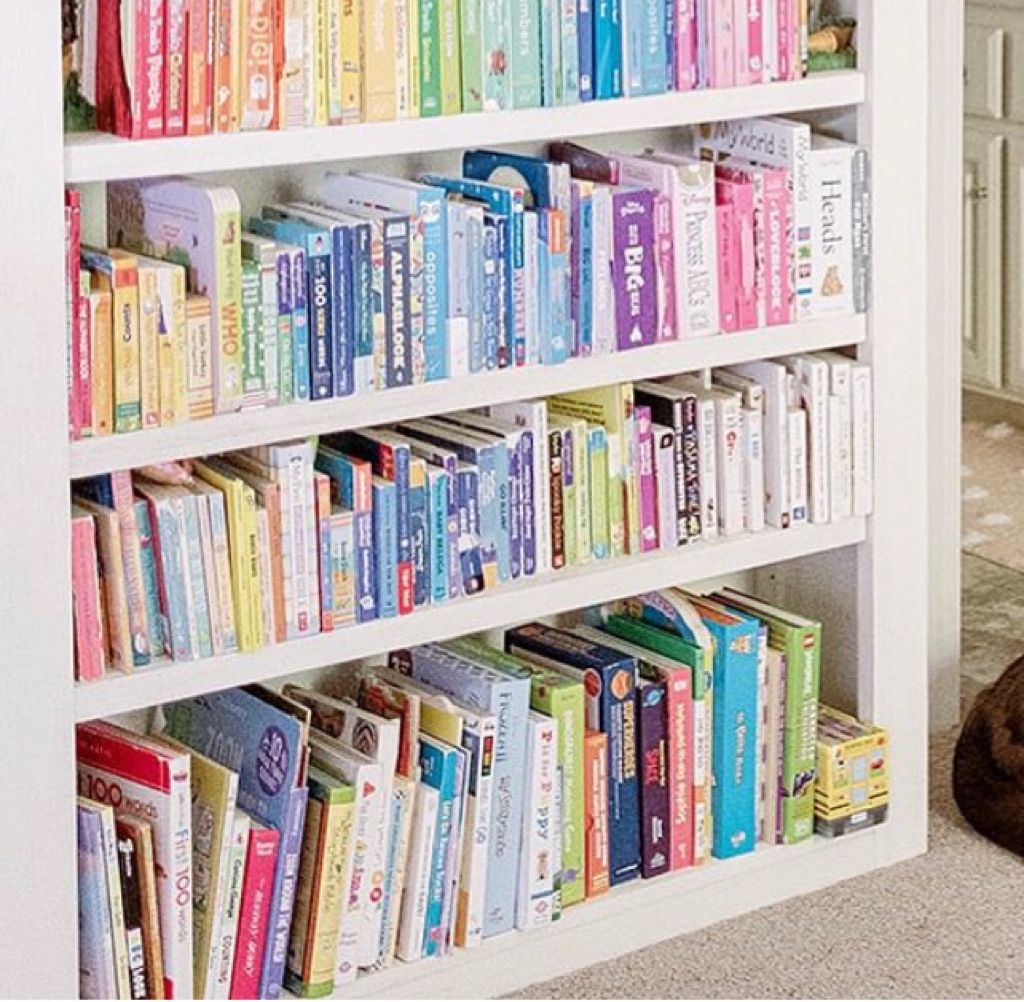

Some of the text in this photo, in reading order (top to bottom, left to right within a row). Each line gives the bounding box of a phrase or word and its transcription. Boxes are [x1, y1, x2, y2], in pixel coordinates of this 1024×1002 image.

[740, 131, 775, 156] World
[820, 179, 844, 256] Heads
[622, 244, 646, 293] BIG
[770, 210, 787, 310] LOVEBLOCK
[314, 276, 328, 306] 100
[389, 250, 406, 369] ALPHABLOCK
[425, 250, 443, 331] opposites
[220, 300, 239, 356] WHO
[541, 730, 554, 743] P
[83, 774, 122, 807] 100
[174, 866, 192, 907] 100
[217, 934, 234, 984] COUNTING
